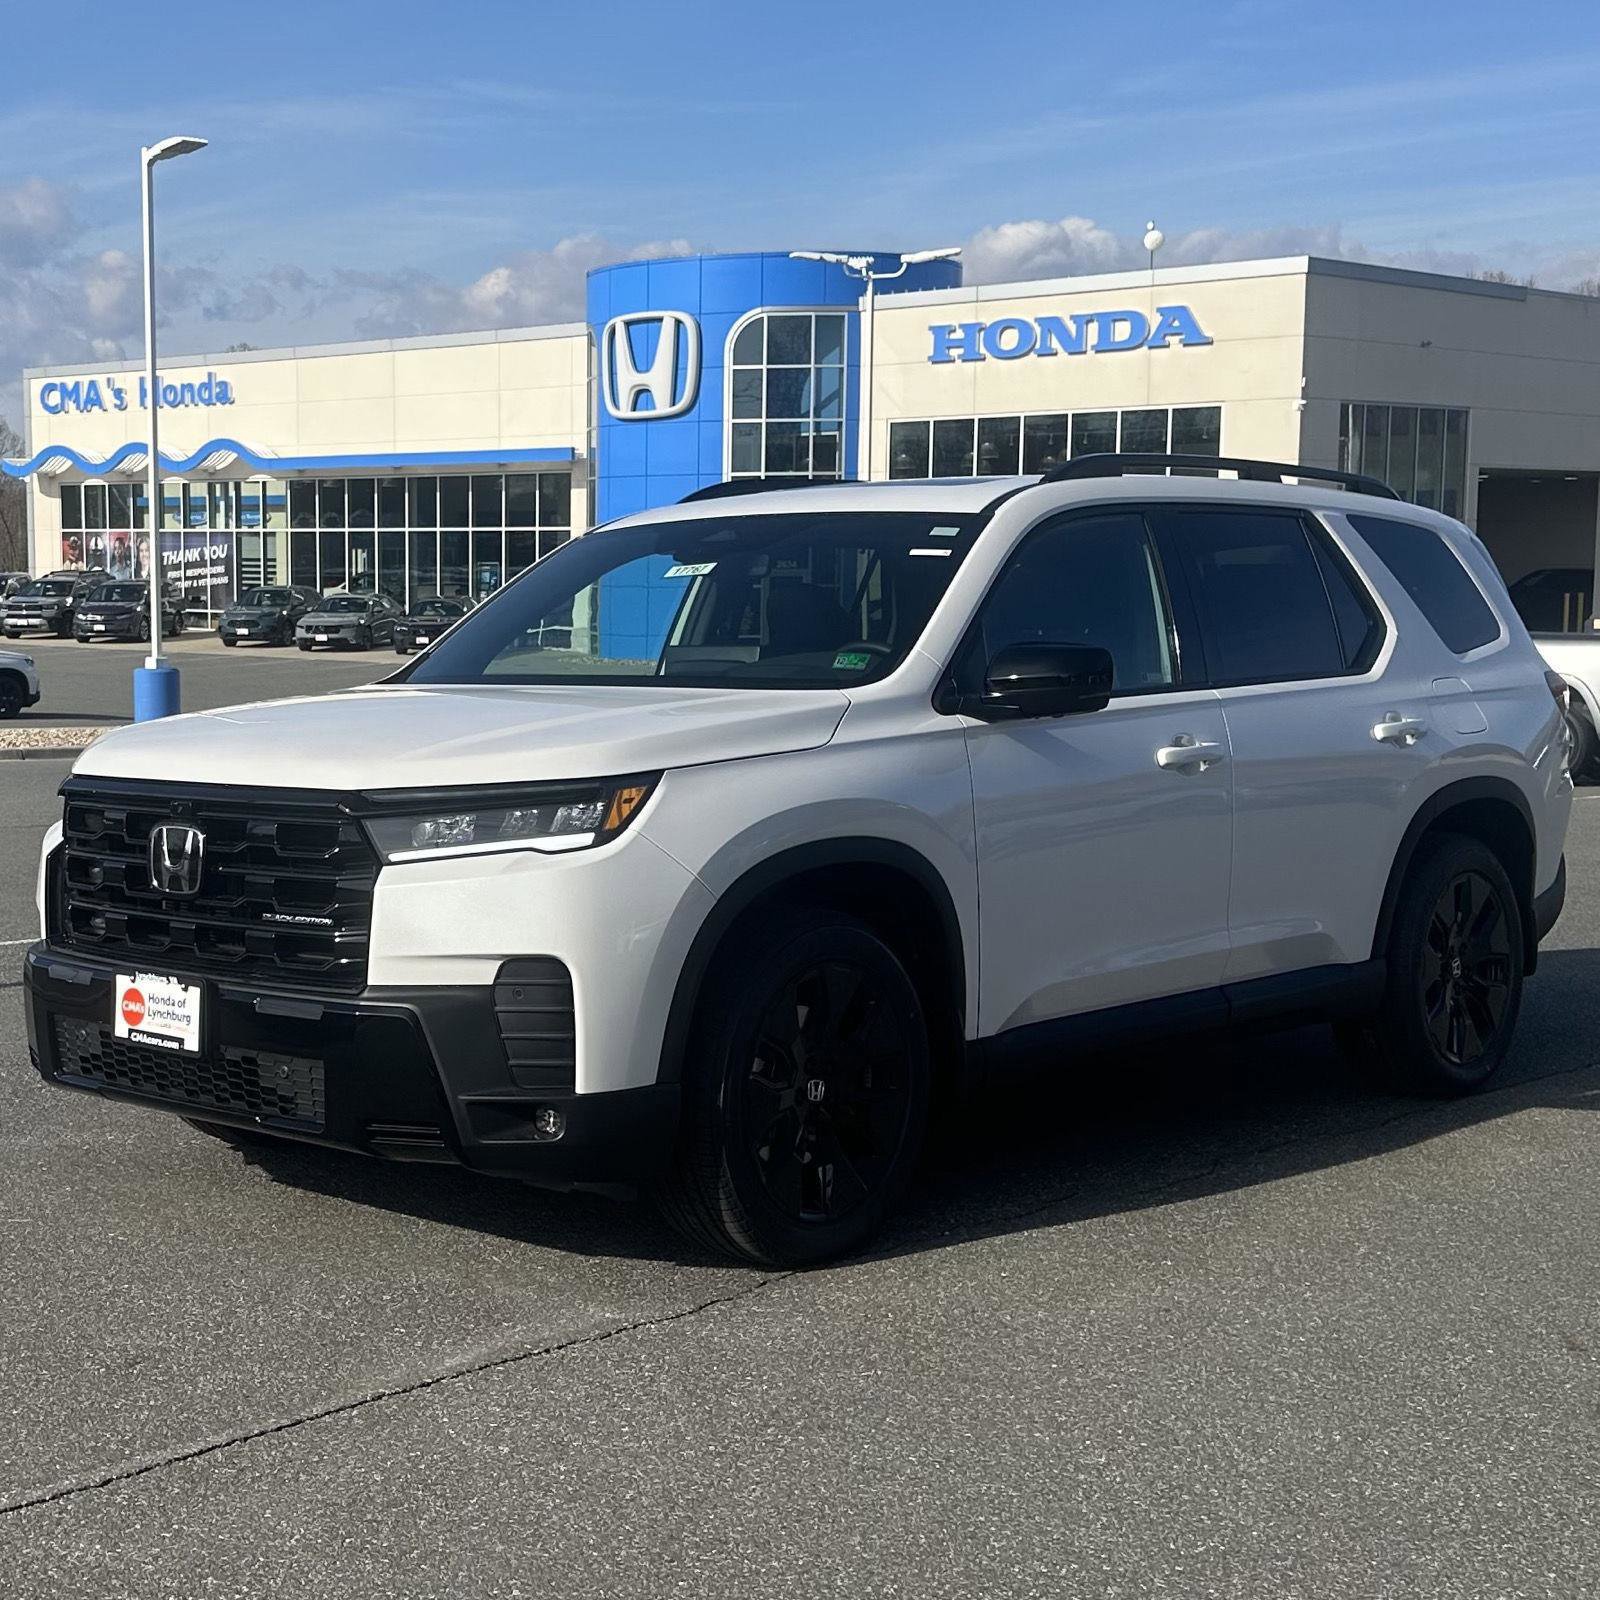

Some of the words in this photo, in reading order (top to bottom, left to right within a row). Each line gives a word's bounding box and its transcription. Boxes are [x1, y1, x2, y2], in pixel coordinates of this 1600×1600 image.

[928, 305, 1213, 364] HONDA
[40, 376, 128, 414] CMA's
[139, 371, 235, 409] Honda
[162, 548, 201, 565] THANK
[203, 543, 228, 560] YOU
[148, 993, 176, 1008] Honda
[177, 998, 187, 1009] of
[147, 1007, 192, 1026] Lynchburg
